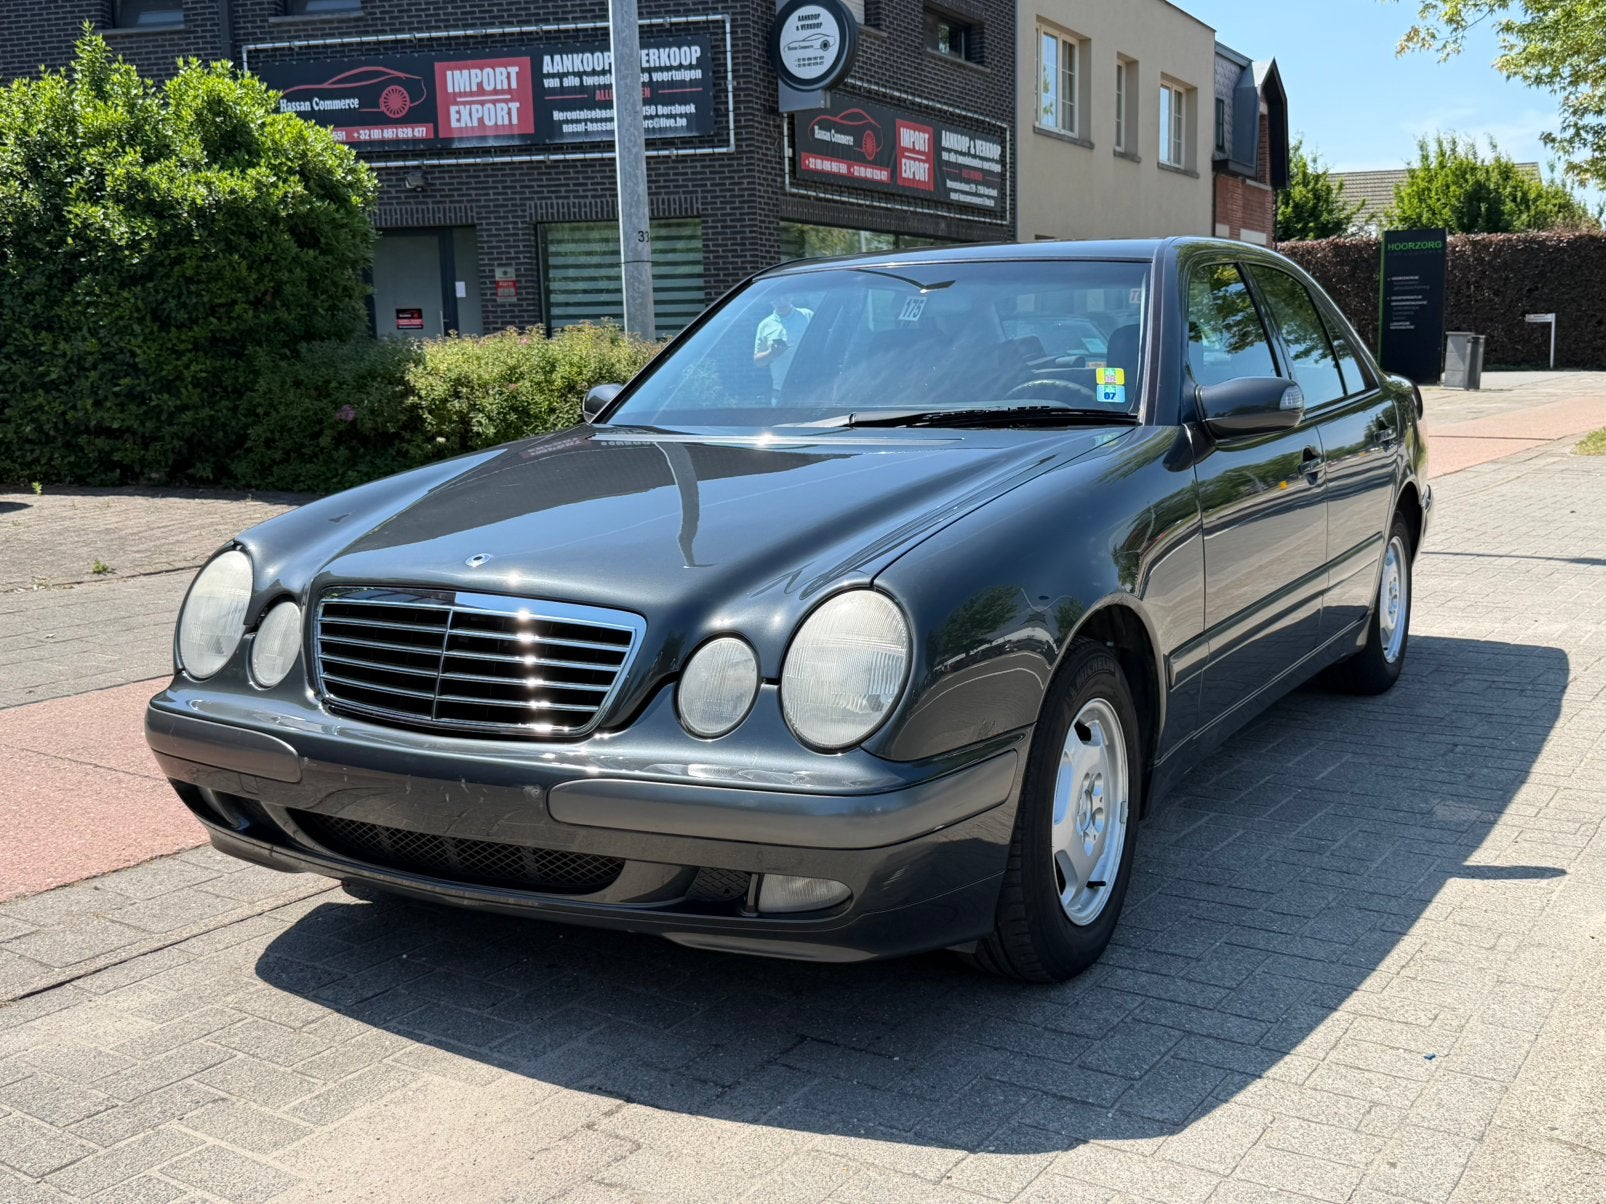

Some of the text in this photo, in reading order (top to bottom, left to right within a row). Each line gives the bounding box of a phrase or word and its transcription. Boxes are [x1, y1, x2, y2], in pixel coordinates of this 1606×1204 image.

[542, 52, 613, 73] AANKOOP
[446, 66, 520, 93] IMPORT
[544, 78, 560, 88] van
[562, 75, 580, 87] alle
[652, 68, 702, 82] voertuigen
[280, 96, 360, 112] Hassan Commerce
[450, 102, 520, 128] EXPORT
[383, 129, 396, 138] 487
[398, 128, 412, 138] 628
[900, 127, 929, 152] IMPORT
[942, 130, 970, 153] AANKOOP
[975, 139, 1002, 160] VERKOOP
[902, 159, 929, 182] EXPORT
[1388, 241, 1442, 251] HOORZORG
[902, 298, 925, 318] 175
